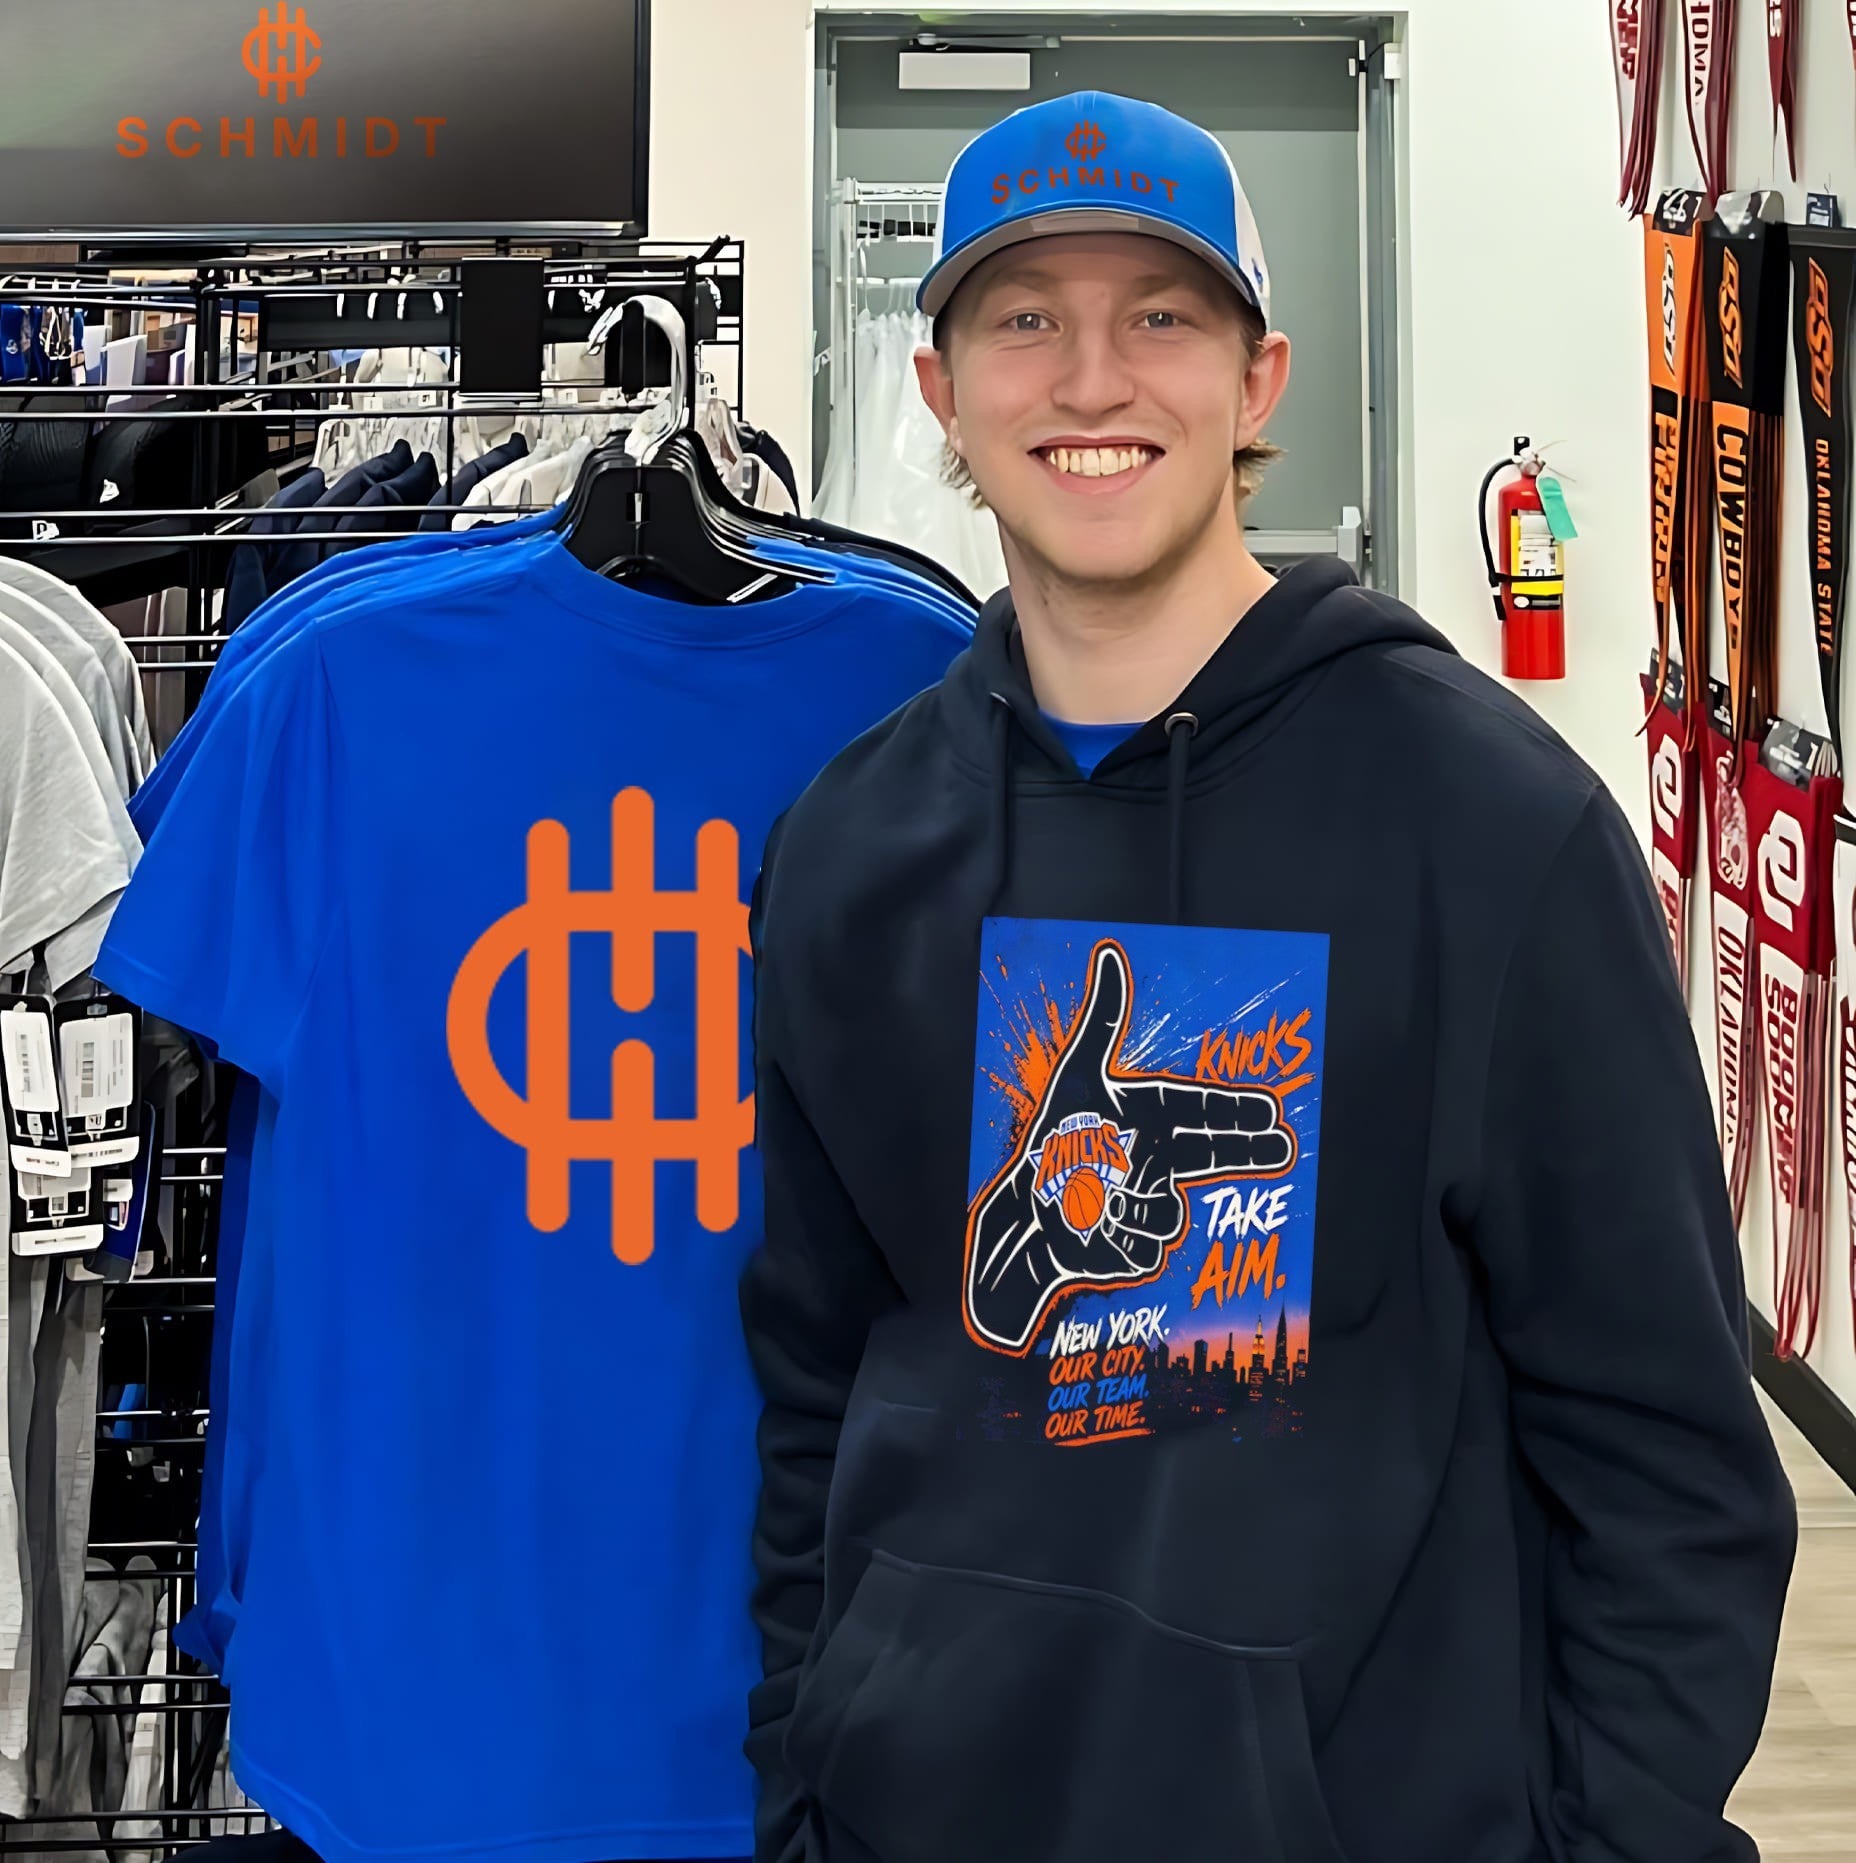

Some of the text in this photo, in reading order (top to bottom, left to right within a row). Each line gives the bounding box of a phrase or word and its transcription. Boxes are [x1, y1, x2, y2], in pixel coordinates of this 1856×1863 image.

[116, 116, 448, 159] SCHMIDT
[991, 165, 1180, 206] SCHMIDT
[1195, 1008, 1312, 1083] KNICKS
[1079, 1114, 1100, 1128] YORK
[1035, 1122, 1130, 1191] KNICKS
[1201, 1184, 1294, 1243] TAKE
[1190, 1233, 1286, 1310] AIM.
[1049, 1303, 1171, 1360] NEW YORK.
[1049, 1345, 1146, 1386] OUR CITY.
[1047, 1373, 1150, 1412] OUR TEAM.
[1044, 1401, 1146, 1439] OUR TIME.
